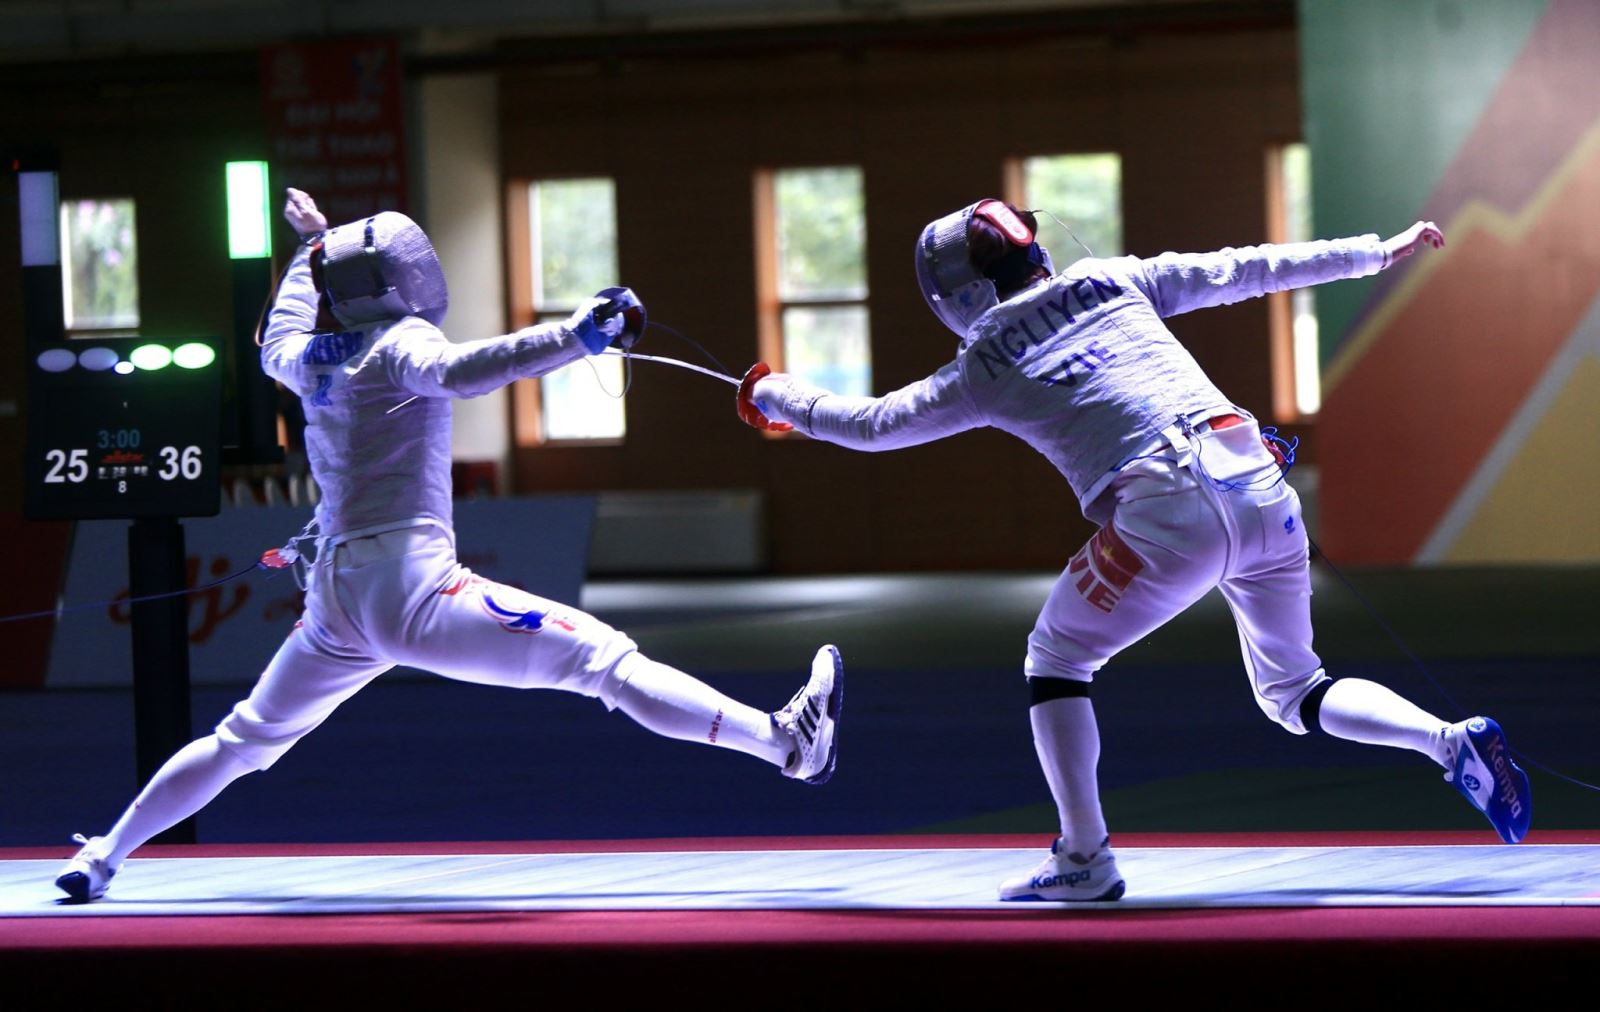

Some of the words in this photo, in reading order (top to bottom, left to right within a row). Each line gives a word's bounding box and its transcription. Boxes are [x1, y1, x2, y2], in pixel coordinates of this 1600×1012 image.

[1037, 341, 1117, 388] VIE
[97, 429, 140, 448] 3:00
[44, 449, 88, 483] 25
[158, 445, 202, 480] 36
[118, 480, 127, 493] 8
[1070, 546, 1120, 613] VIE
[1487, 734, 1522, 819] Kempa
[1030, 870, 1090, 889] Kempa
